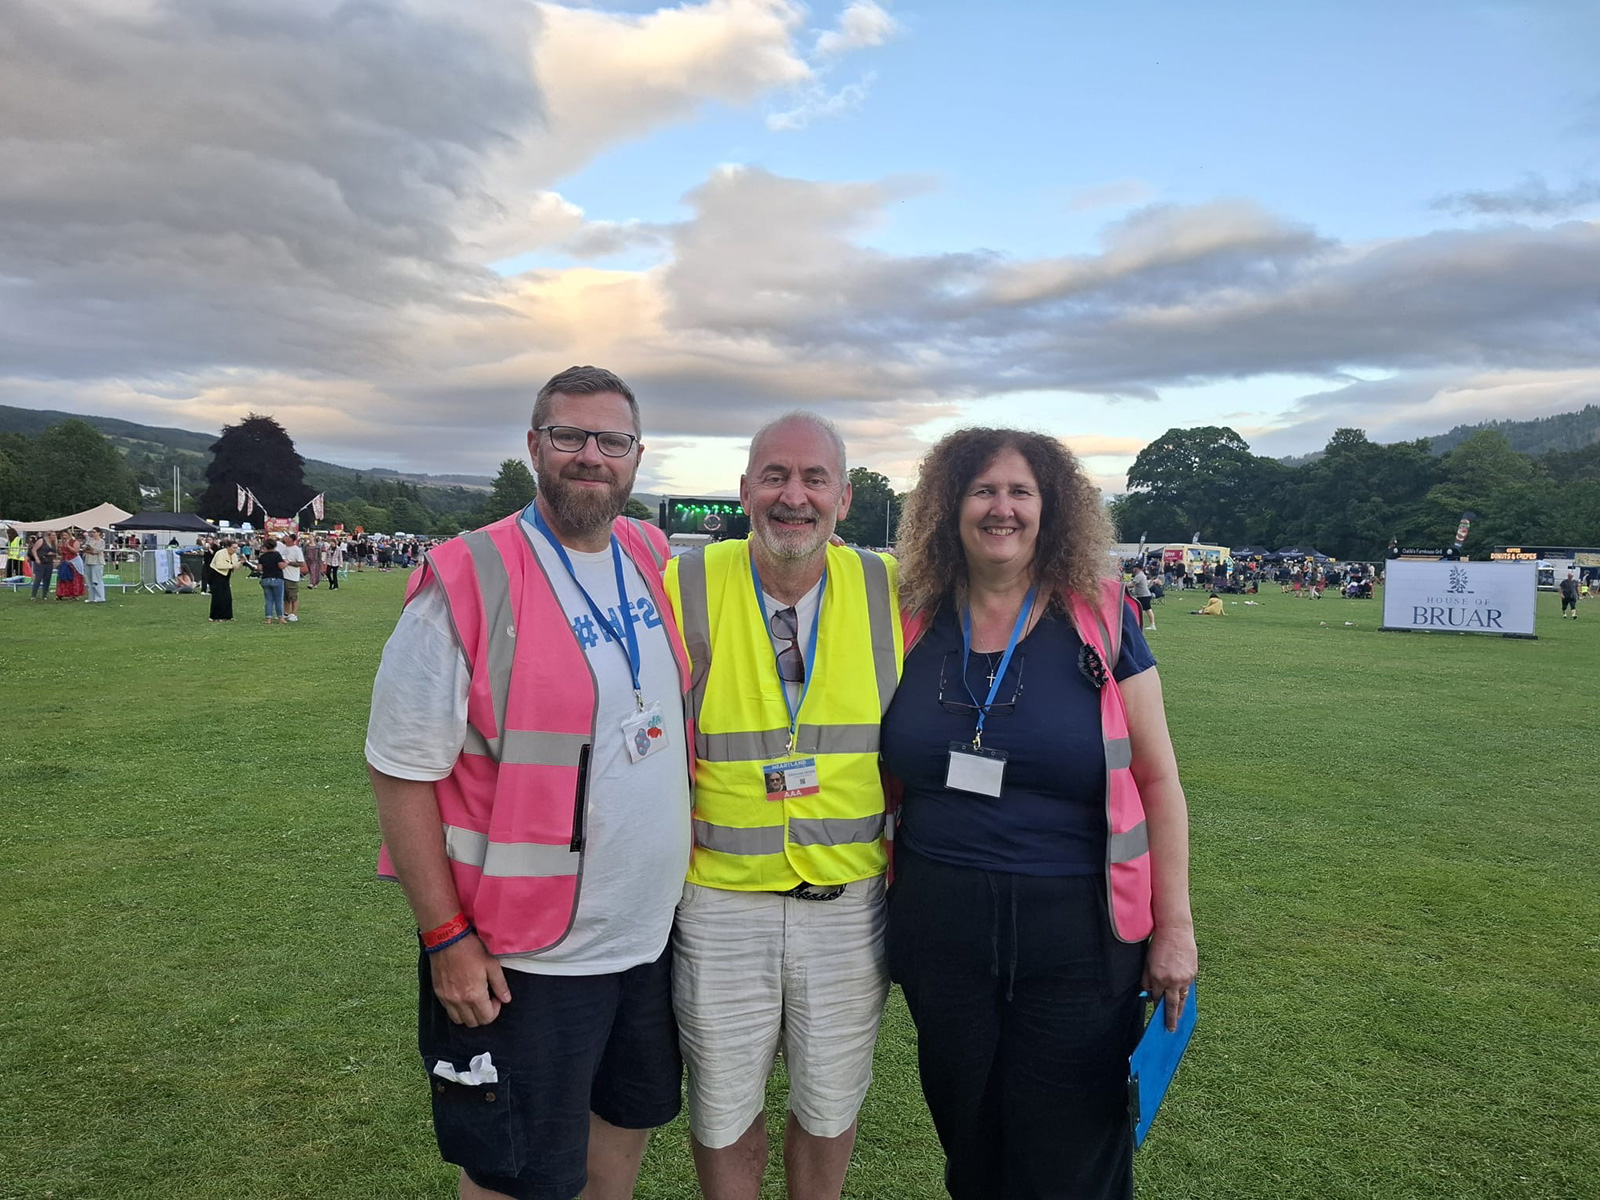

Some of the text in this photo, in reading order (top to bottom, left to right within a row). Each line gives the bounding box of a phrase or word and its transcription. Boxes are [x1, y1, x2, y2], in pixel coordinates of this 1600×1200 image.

[1427, 597, 1468, 605] HOUSE
[1412, 606, 1503, 629] BRUAR
[771, 760, 807, 769] HEARTLAND
